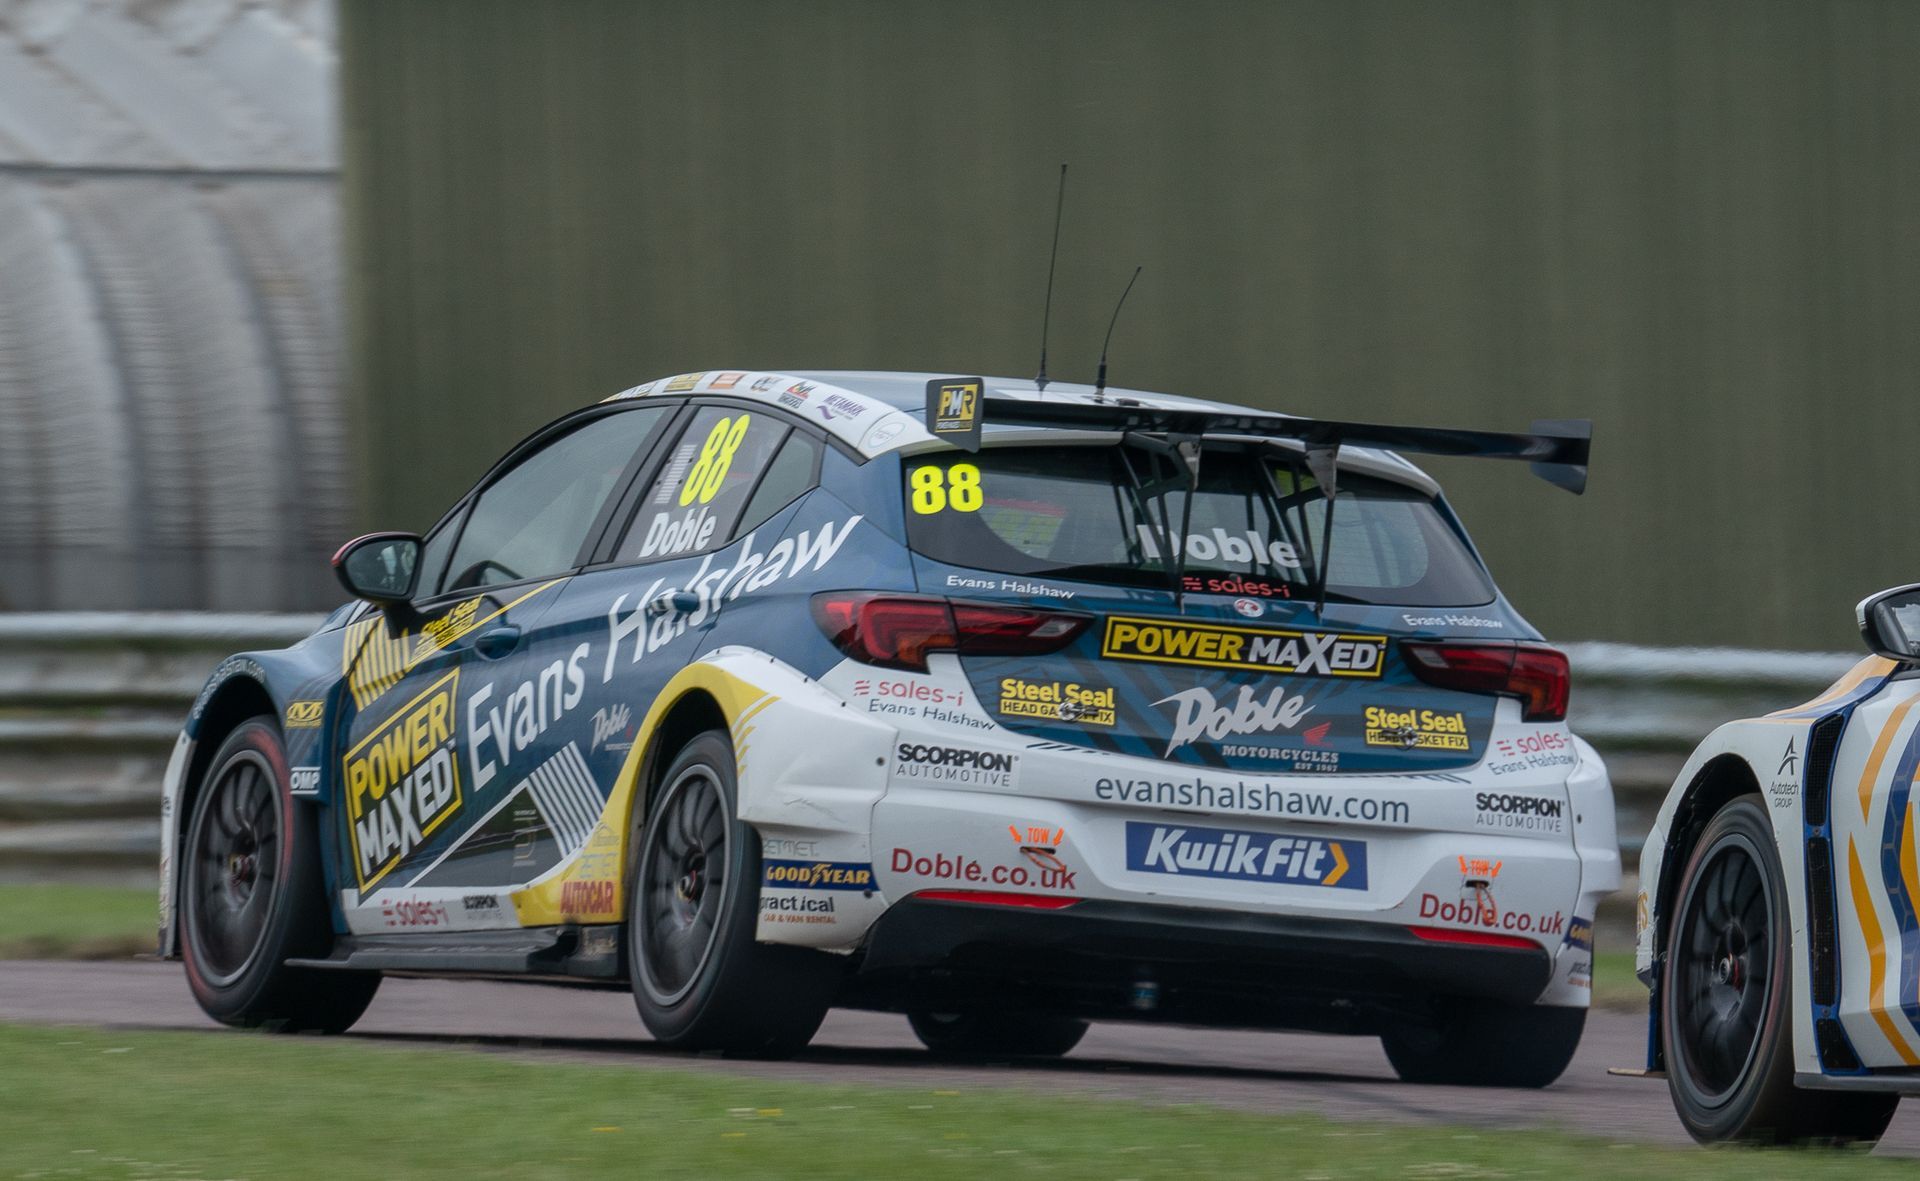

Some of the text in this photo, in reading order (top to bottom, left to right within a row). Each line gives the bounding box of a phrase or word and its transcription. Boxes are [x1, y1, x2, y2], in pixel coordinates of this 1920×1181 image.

[939, 389, 974, 417] PMR
[679, 413, 751, 508] 88
[909, 463, 985, 516] 88
[639, 506, 718, 558] Doble
[946, 575, 1075, 600] Evans Halshaw
[1402, 614, 1503, 628] Evans Halshaw
[467, 513, 865, 794] Evans Halshaw
[1111, 623, 1245, 661] POWER
[877, 680, 964, 707] sales-i
[1000, 678, 1116, 709] Steel Seal
[1002, 701, 1038, 714] HEAD
[868, 698, 996, 731] Evans Halshaw
[1147, 684, 1317, 759] Doble
[1365, 706, 1467, 733] Steel Seal
[349, 690, 450, 819] POWER
[1222, 745, 1339, 764] MOTORCYCLES
[1448, 736, 1466, 748] FIX
[898, 743, 1013, 773] SCORPION
[1294, 762, 1312, 770] EST
[290, 771, 320, 791] OMP
[896, 764, 1012, 788] AUTOMOTIVE
[355, 747, 455, 876] MAXED
[1095, 777, 1410, 823] evanshalshaw.com
[1475, 792, 1562, 818] SCORPION
[1027, 827, 1050, 845] TOW
[1475, 813, 1563, 833] AUTOMOTIVE
[766, 863, 871, 888] GOODYEAR
[891, 847, 1077, 890] Doble.co.uk
[1470, 860, 1490, 876] TOW
[560, 881, 614, 914] AUTOCAR
[1419, 893, 1565, 935] Doble.co.uk
